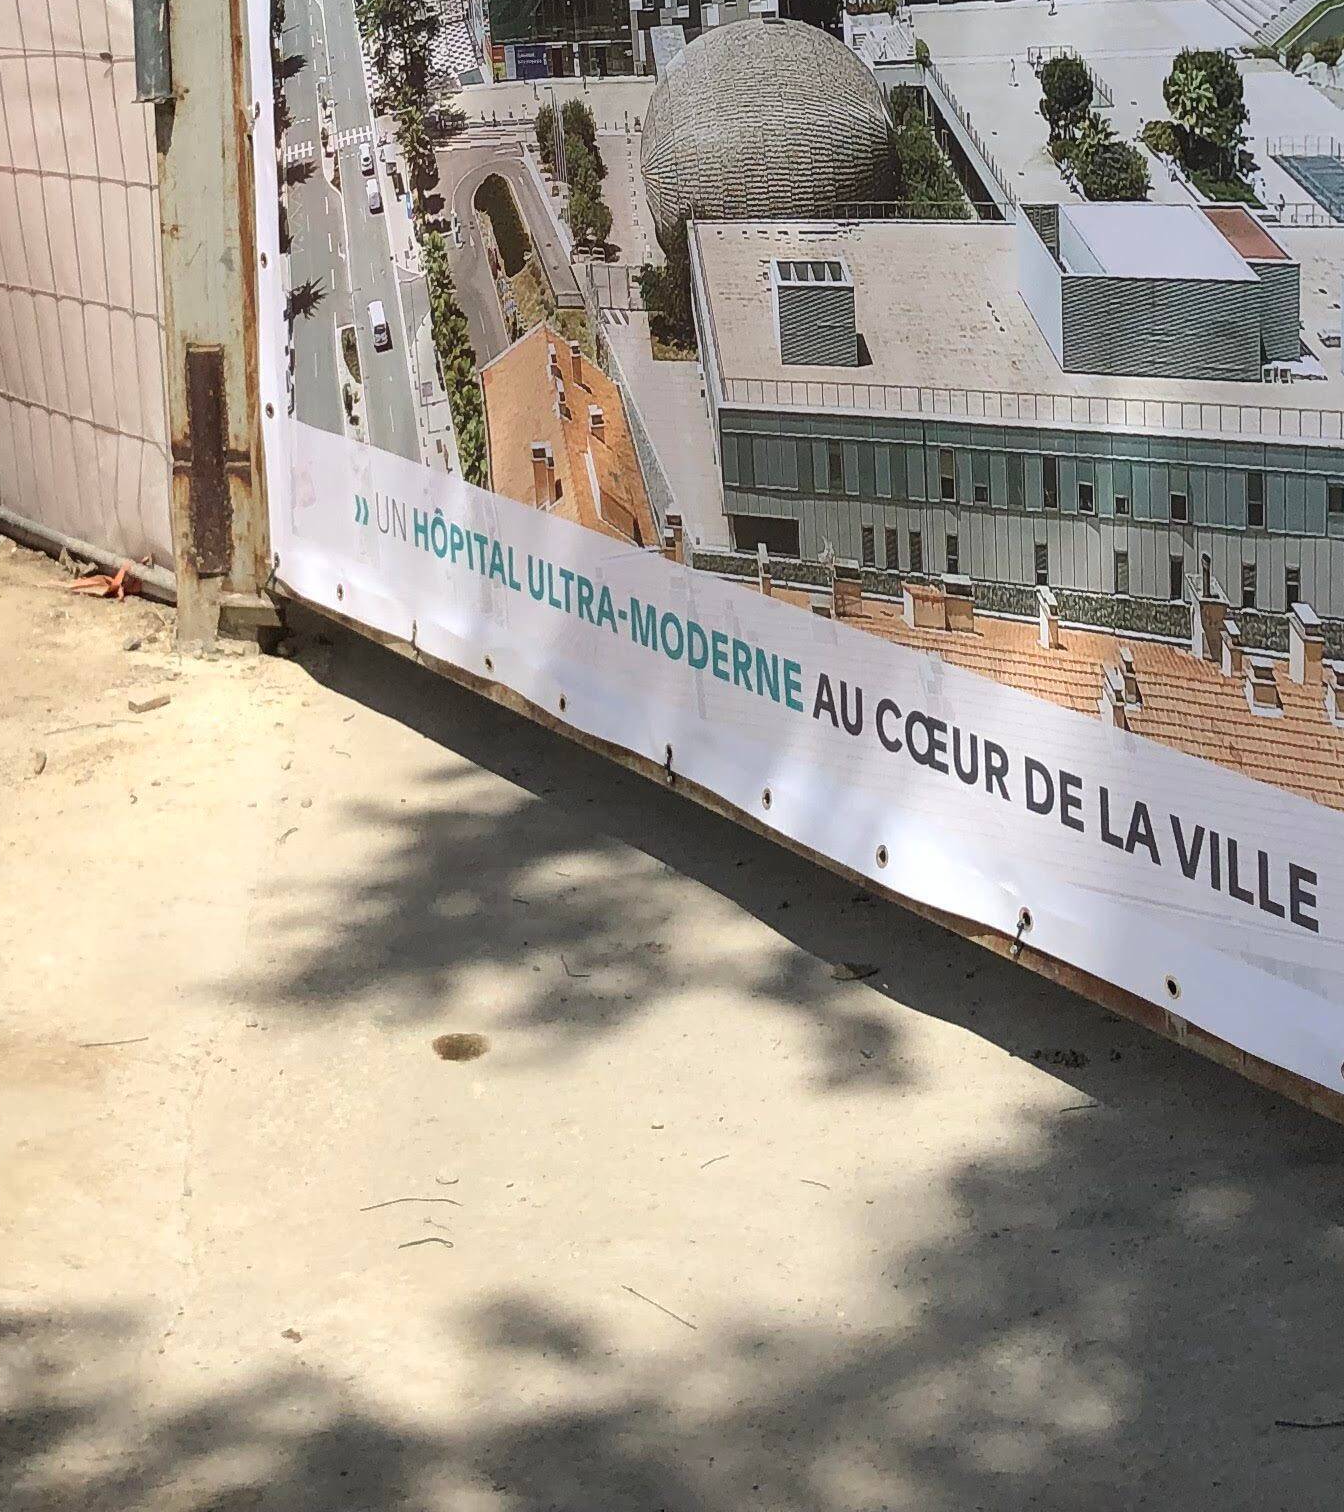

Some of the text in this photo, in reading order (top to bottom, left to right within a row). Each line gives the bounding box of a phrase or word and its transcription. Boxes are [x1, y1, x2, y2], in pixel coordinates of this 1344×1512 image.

[376, 495, 1320, 934] UN HÔPITAL ULTRA-MODERNE AU CŒUR DE LA VILLE
